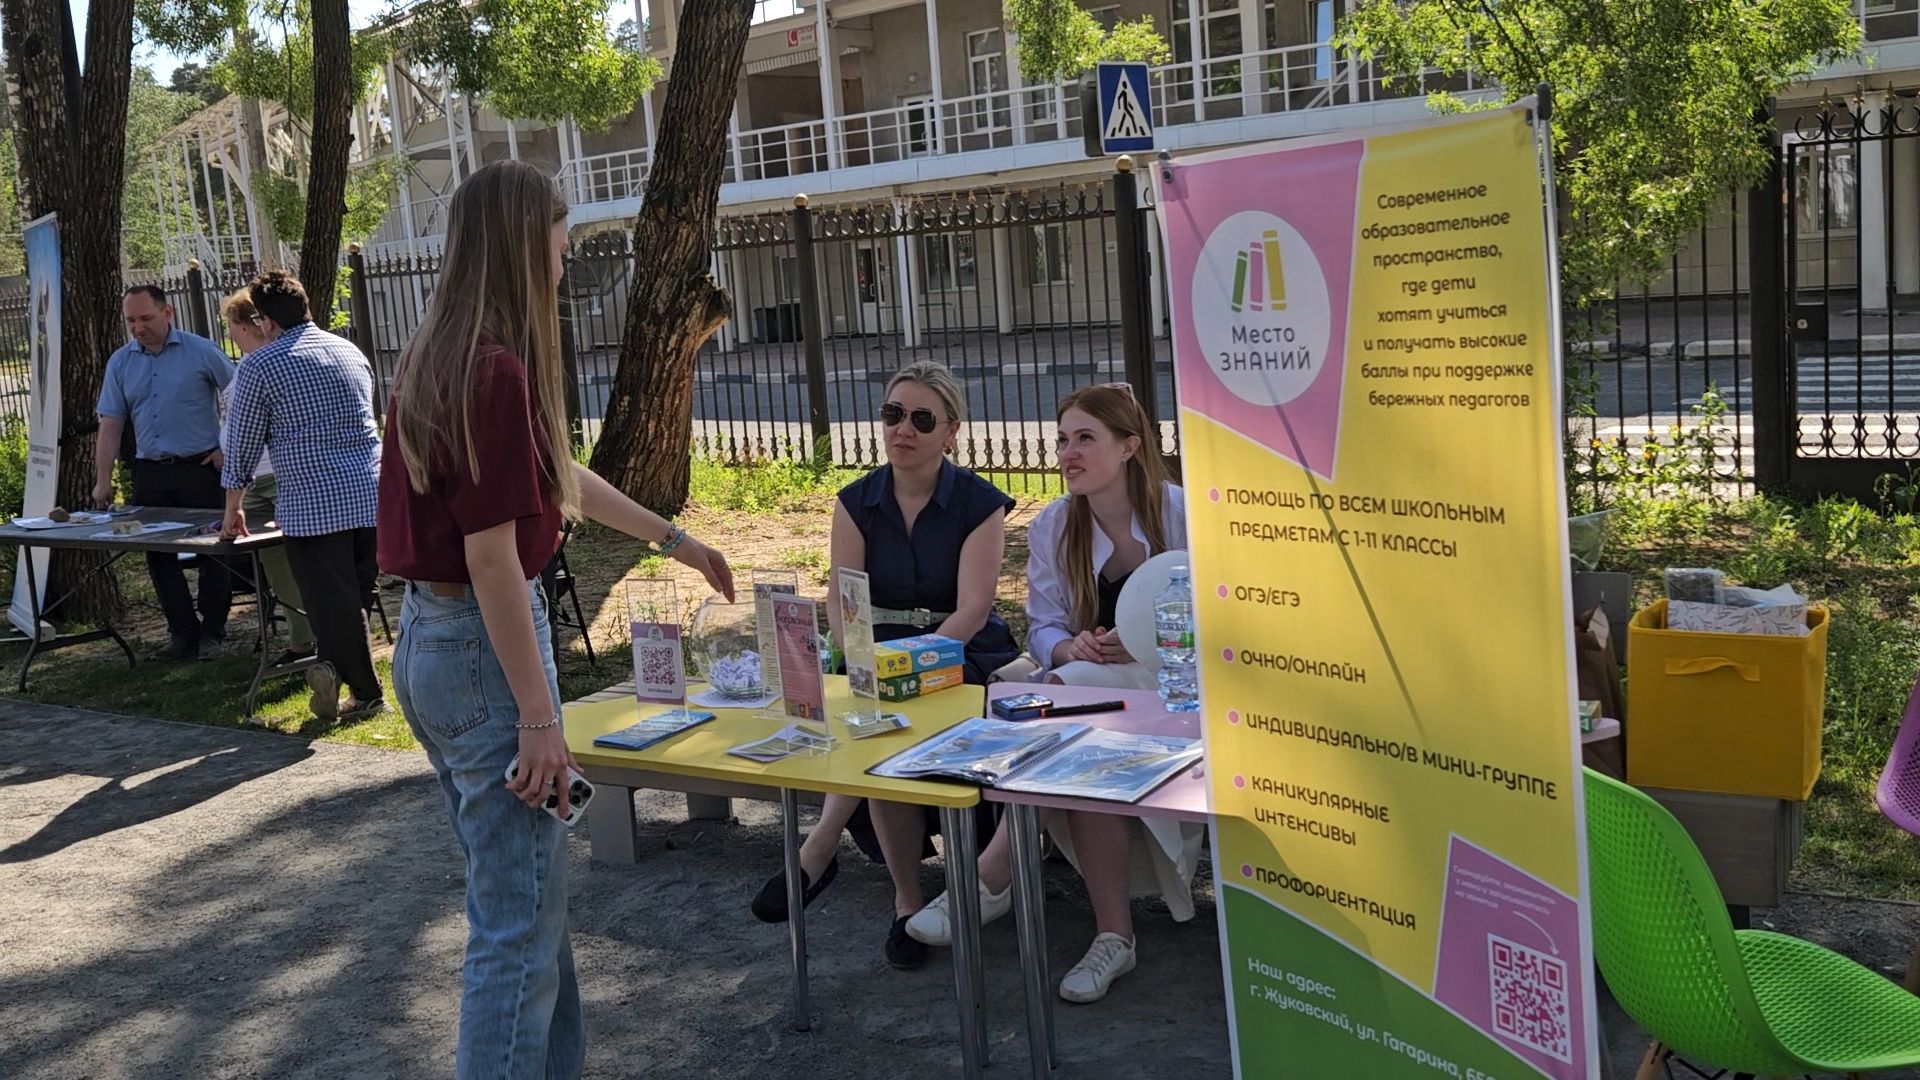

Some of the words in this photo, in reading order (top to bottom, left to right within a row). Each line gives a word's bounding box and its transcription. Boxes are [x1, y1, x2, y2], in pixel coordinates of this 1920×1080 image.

[1377, 184, 1488, 210] Современное
[1361, 211, 1511, 241] образовательное
[1373, 244, 1503, 270] пространство,
[1401, 279, 1427, 296] где
[1431, 277, 1476, 295] дети
[1377, 308, 1432, 323] хотят
[1436, 304, 1508, 324] учиться
[1231, 325, 1295, 345] Место
[1363, 339, 1374, 351] и
[1377, 337, 1456, 353] получать
[1459, 333, 1528, 349] высокие
[1219, 345, 1311, 372] ЗНАНИЙ
[1361, 363, 1409, 379] баллы
[1413, 366, 1441, 381] при
[1445, 363, 1535, 381] поддержке
[1368, 390, 1445, 409] бережных
[1449, 394, 1530, 410] педагогов
[1226, 489, 1305, 510] ПОМОЩЬ
[1309, 493, 1335, 511] ПО
[1339, 495, 1386, 514] ВСЕМ
[1391, 499, 1505, 525] ШКОЛЬНЫМ
[1229, 521, 1335, 545] ПРЕДМЕТАМ
[1338, 529, 1350, 546] С
[1353, 530, 1377, 549] 1-11
[1382, 534, 1457, 558] КЛАССЫ
[1235, 585, 1300, 607] ОГЭ/ЕГЭ
[1241, 650, 1366, 684] ОЧНО/ОНЛАЙН
[1246, 713, 1418, 763] ИНДИВИДУАЛЬНО/В
[1422, 750, 1557, 800] МИНИ-ГРУППЕ
[1251, 775, 1390, 823] КАНИКУЛЯРНЫЕ
[1254, 806, 1356, 846] ИНТЕНСИВЫ
[1255, 867, 1416, 931] ПРОФОРИЕНТАЦИЯ
[1248, 957, 1284, 980] Наш
[1286, 972, 1336, 1000] адрес:
[1250, 985, 1262, 998] г.
[1264, 985, 1354, 1034] Жуковский,
[1356, 1023, 1380, 1043] ул.
[1383, 1031, 1462, 1080] Гагарина,
